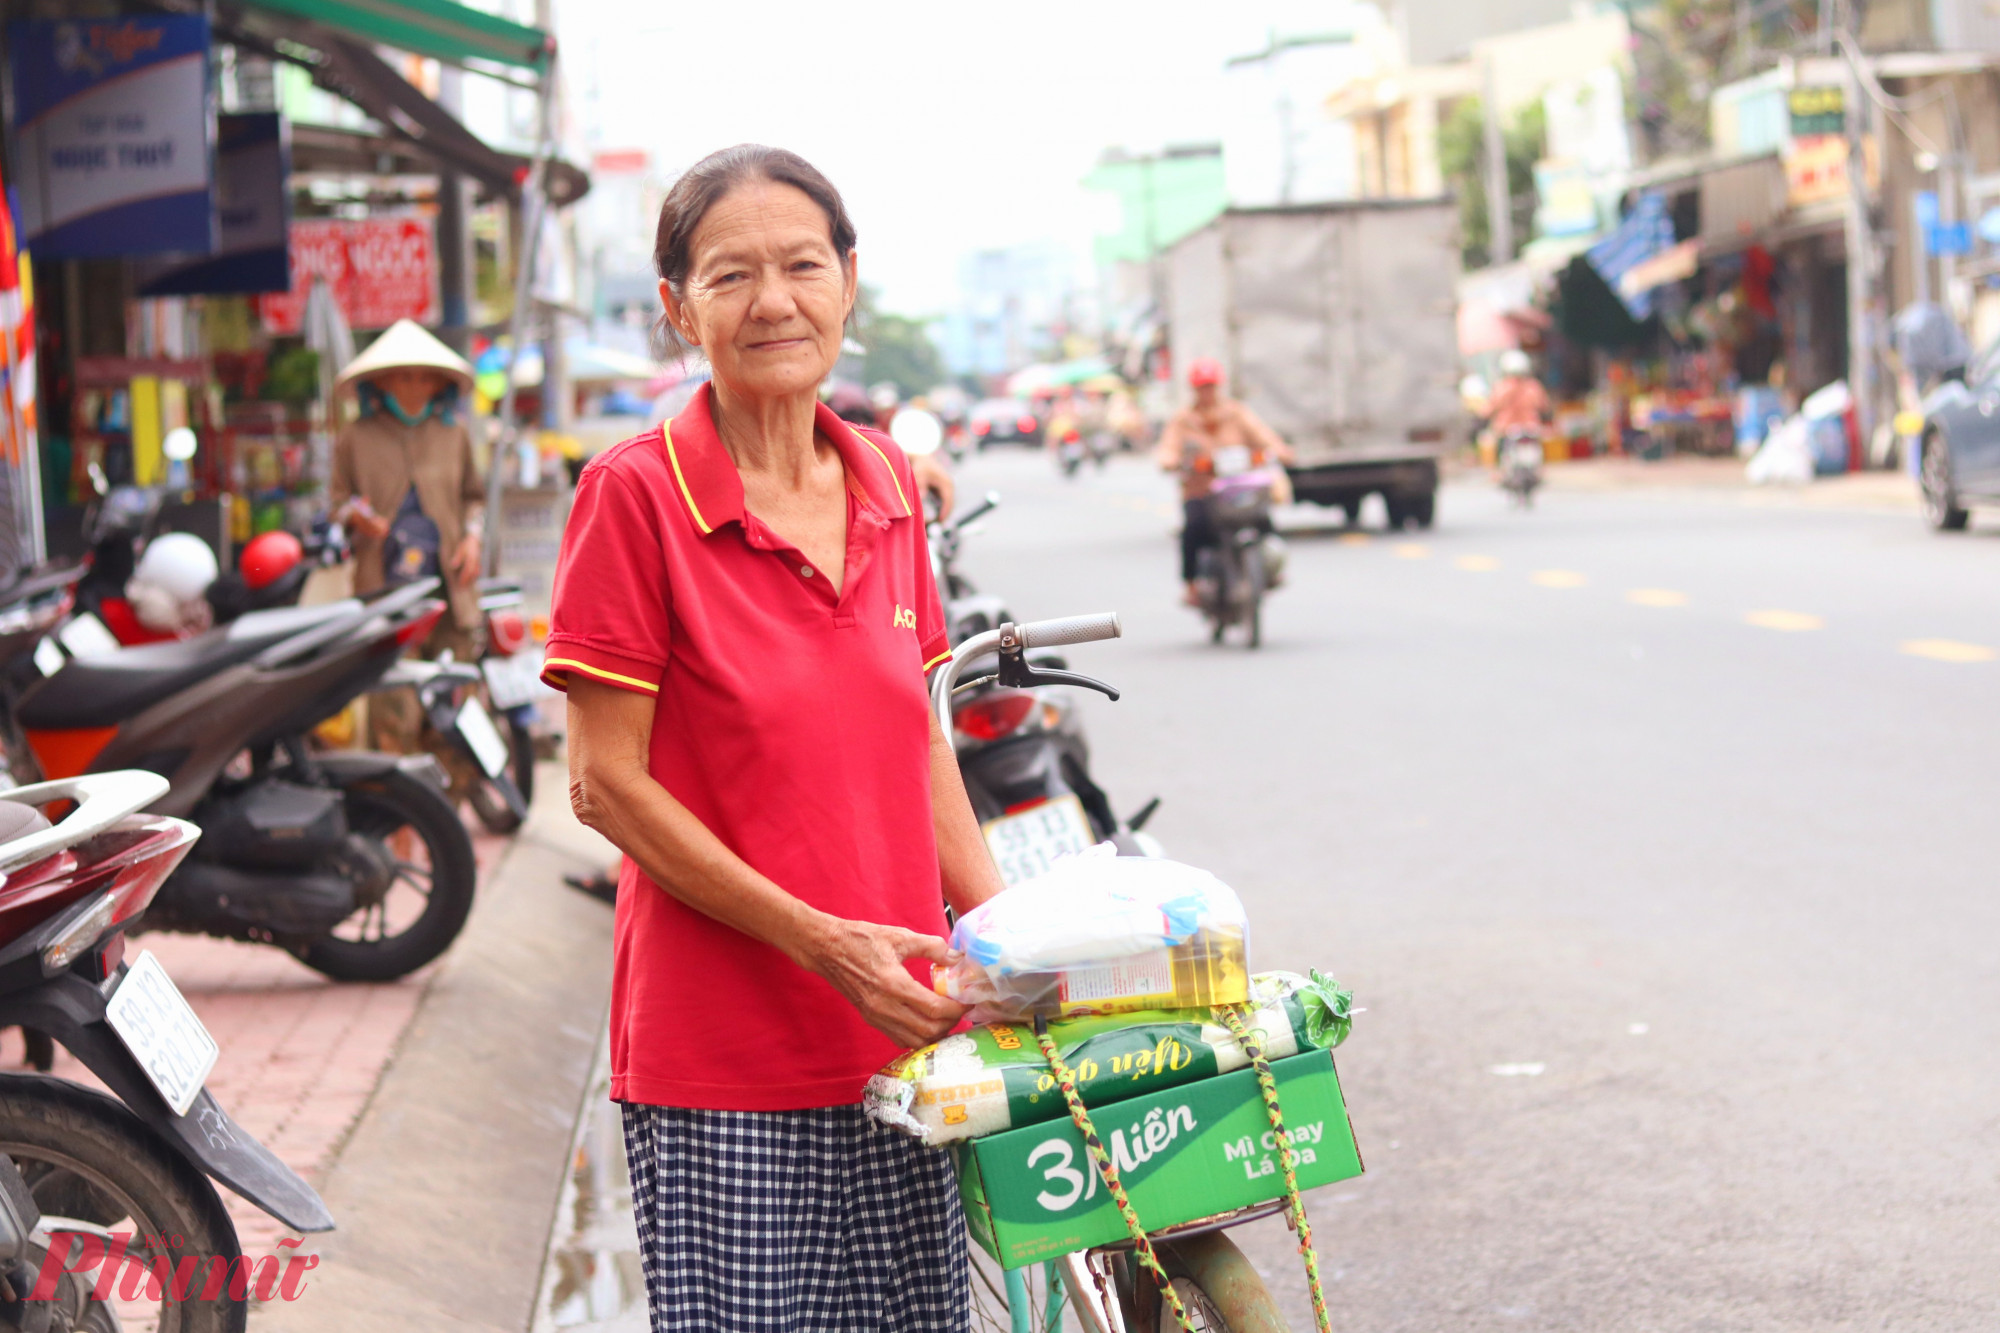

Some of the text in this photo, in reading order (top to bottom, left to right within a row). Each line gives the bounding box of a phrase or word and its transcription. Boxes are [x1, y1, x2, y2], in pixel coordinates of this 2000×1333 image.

[1107, 1035, 1192, 1081] Yến
[1223, 1135, 1256, 1162] Mì
[1243, 1153, 1276, 1180] Lá
